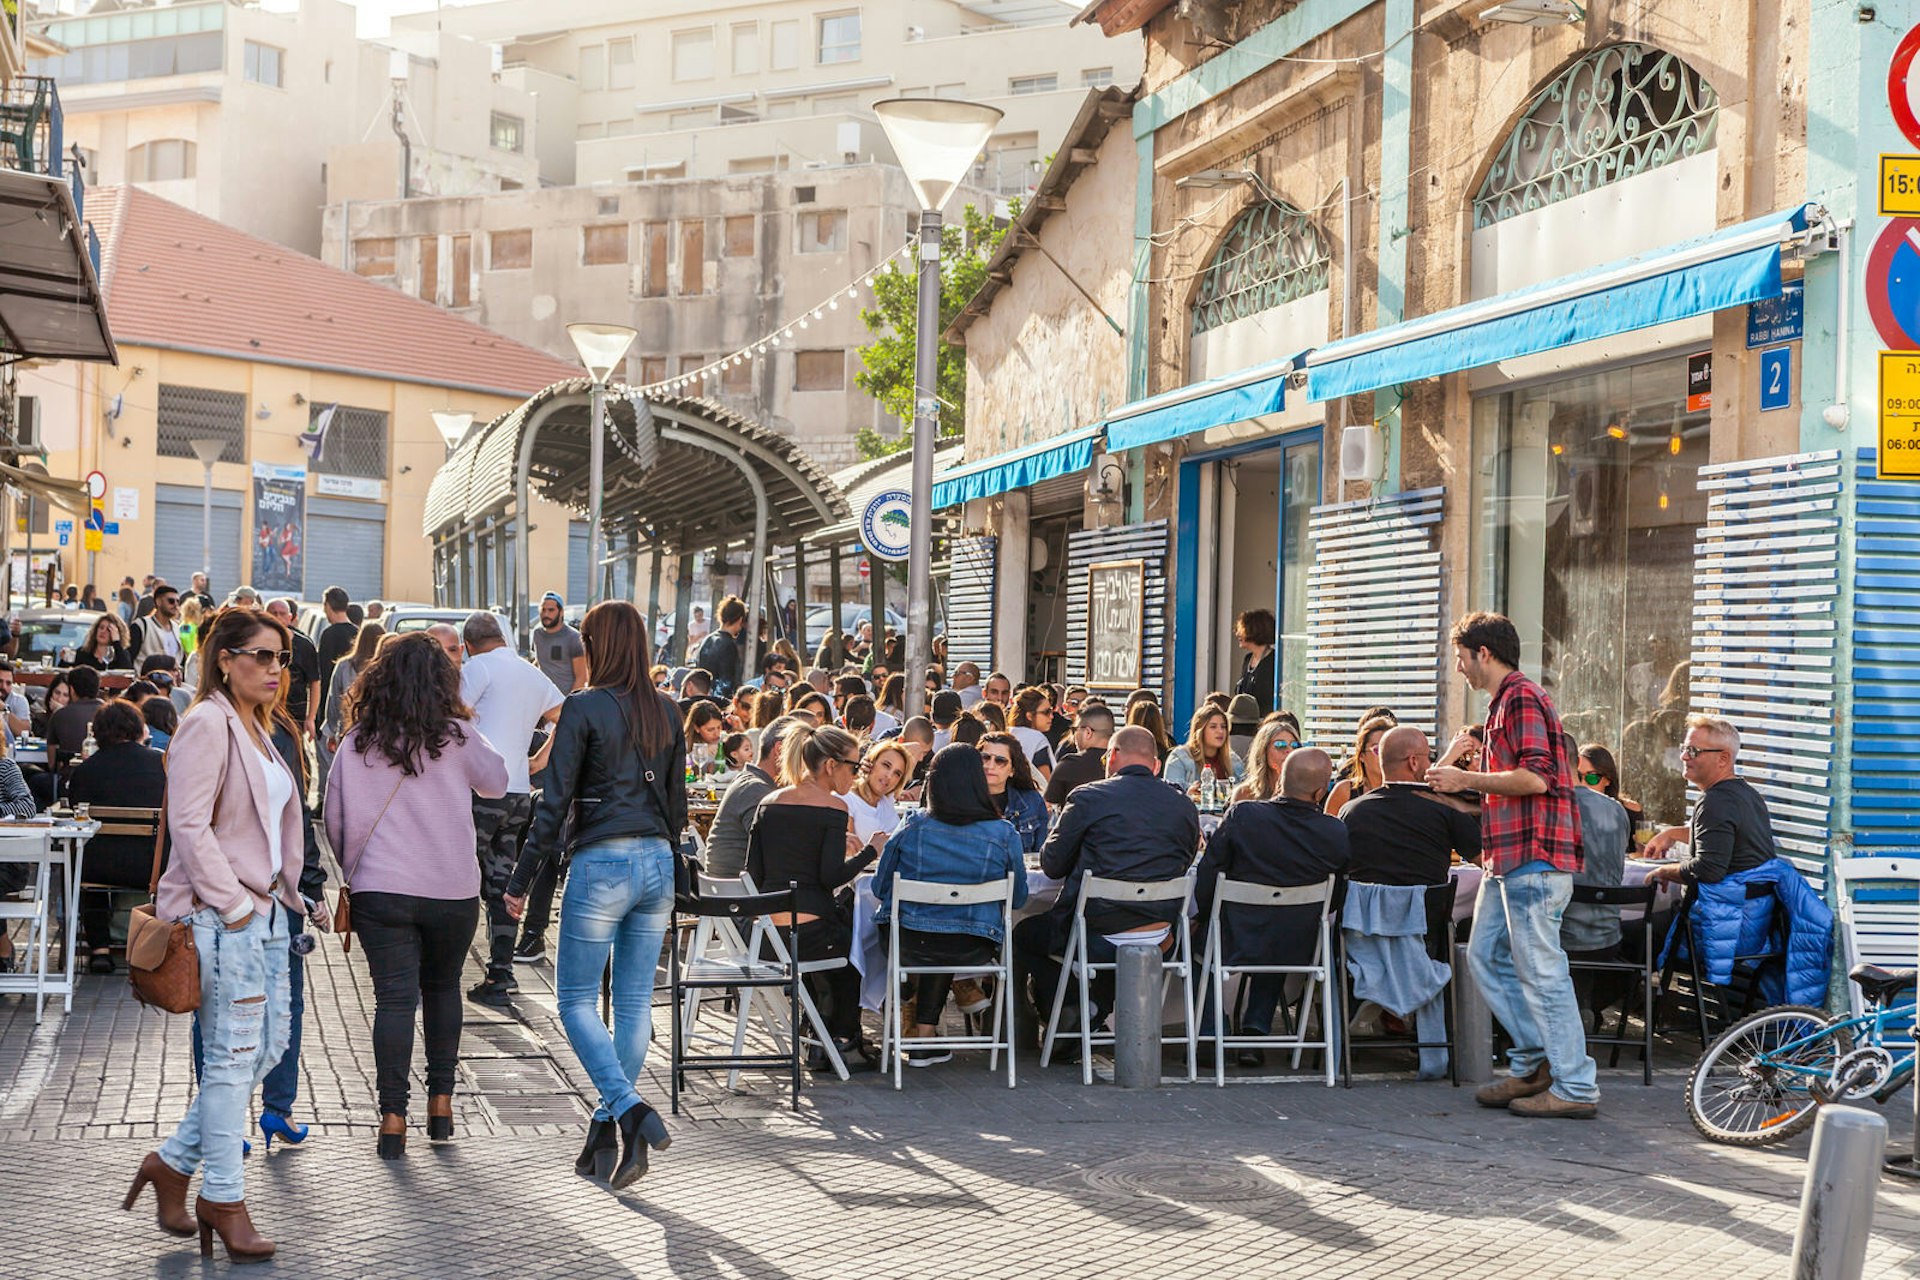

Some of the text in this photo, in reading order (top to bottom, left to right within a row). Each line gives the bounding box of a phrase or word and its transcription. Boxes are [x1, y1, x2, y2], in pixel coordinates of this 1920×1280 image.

[1888, 174, 1920, 194] 15:
[1750, 331, 1768, 343] RABBI
[1769, 361, 1782, 395] 2
[1108, 608, 1130, 628] יוונית
[1114, 650, 1138, 678] שמח
